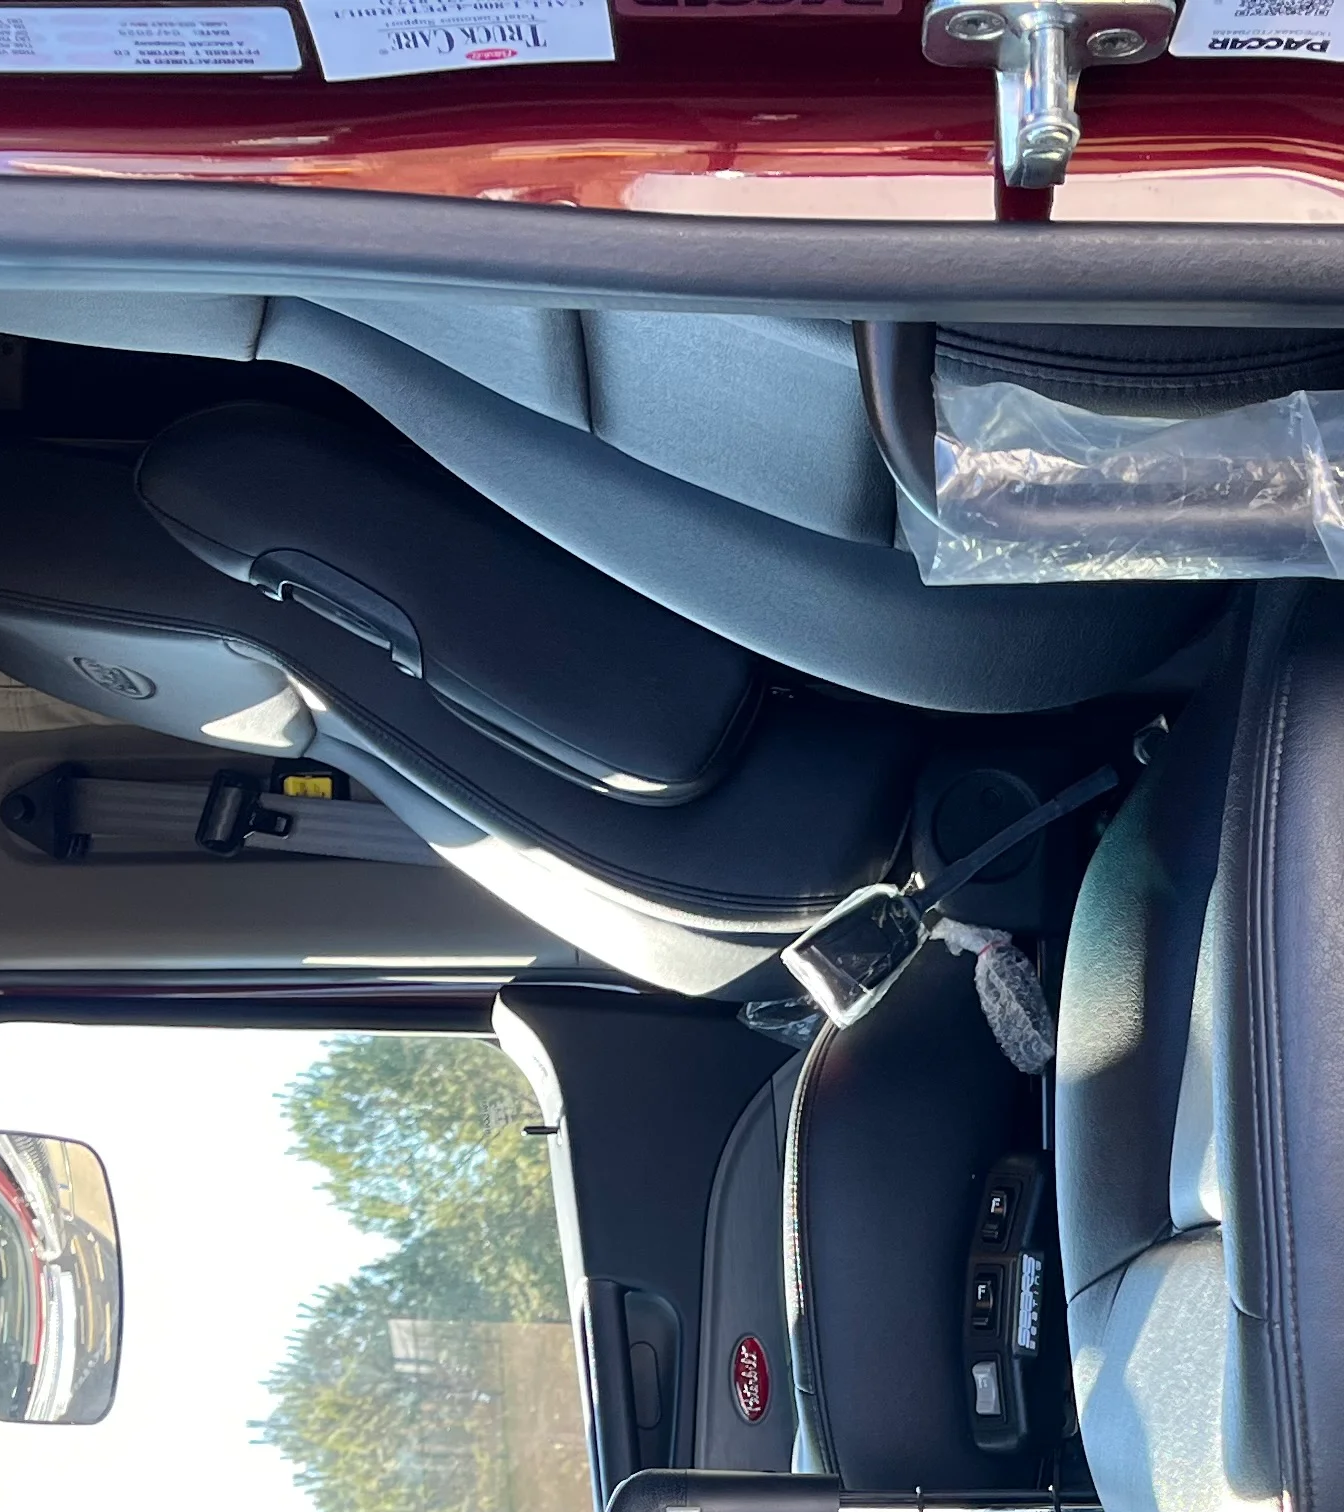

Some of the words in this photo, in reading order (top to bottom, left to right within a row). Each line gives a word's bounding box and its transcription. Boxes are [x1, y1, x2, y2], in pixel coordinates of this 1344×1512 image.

[386, 28, 455, 55] CARE
[459, 24, 547, 48] TRUCK
[1208, 37, 1331, 53] PACCAR
[736, 1345, 761, 1415] Peterbilt
